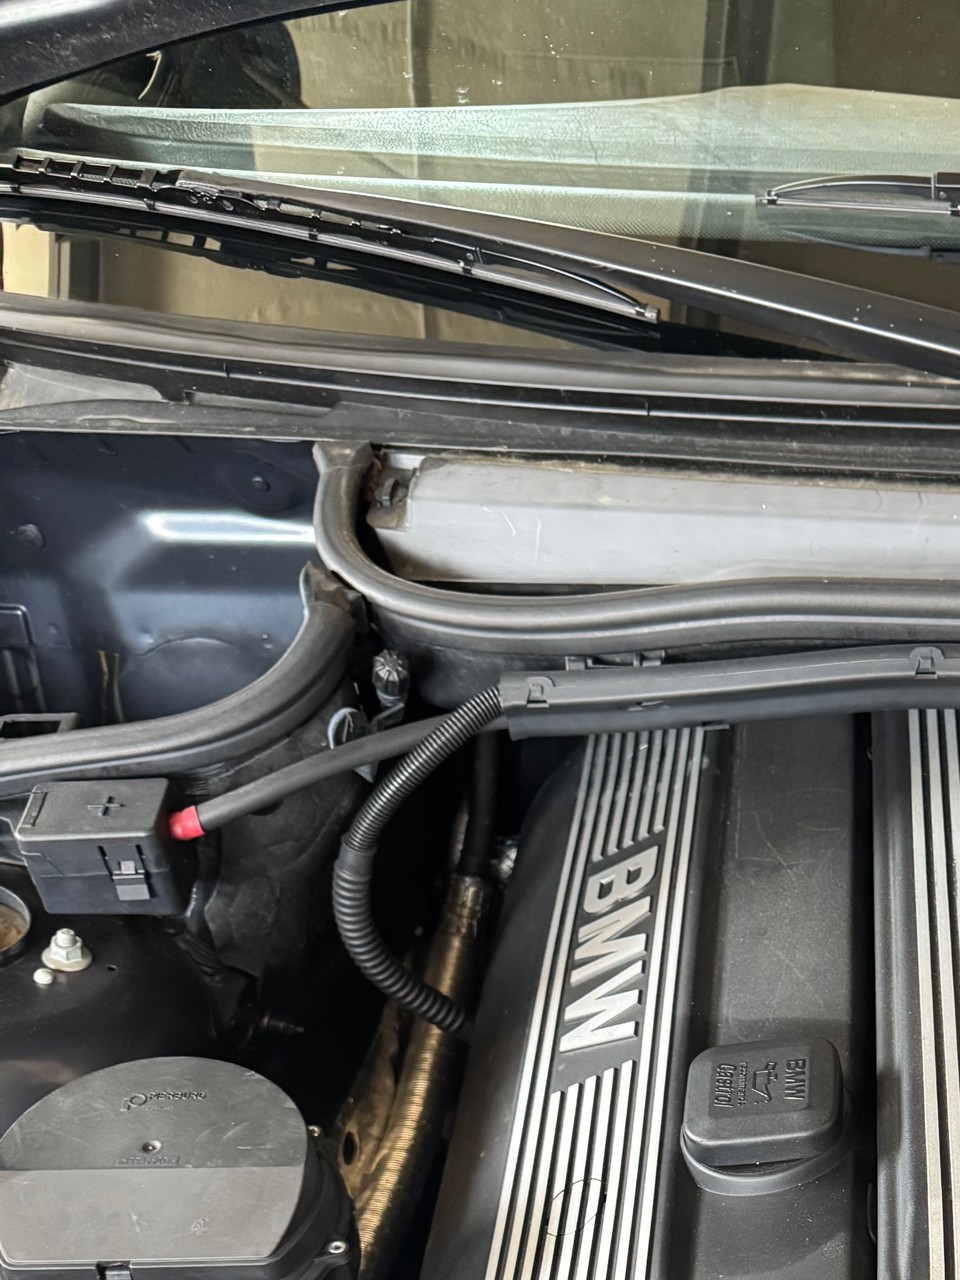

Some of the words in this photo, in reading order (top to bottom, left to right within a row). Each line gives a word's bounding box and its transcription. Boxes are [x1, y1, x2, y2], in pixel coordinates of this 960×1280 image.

[559, 845, 660, 1053] BMW
[713, 1063, 737, 1108] Castrol
[783, 1058, 807, 1101] BMW
